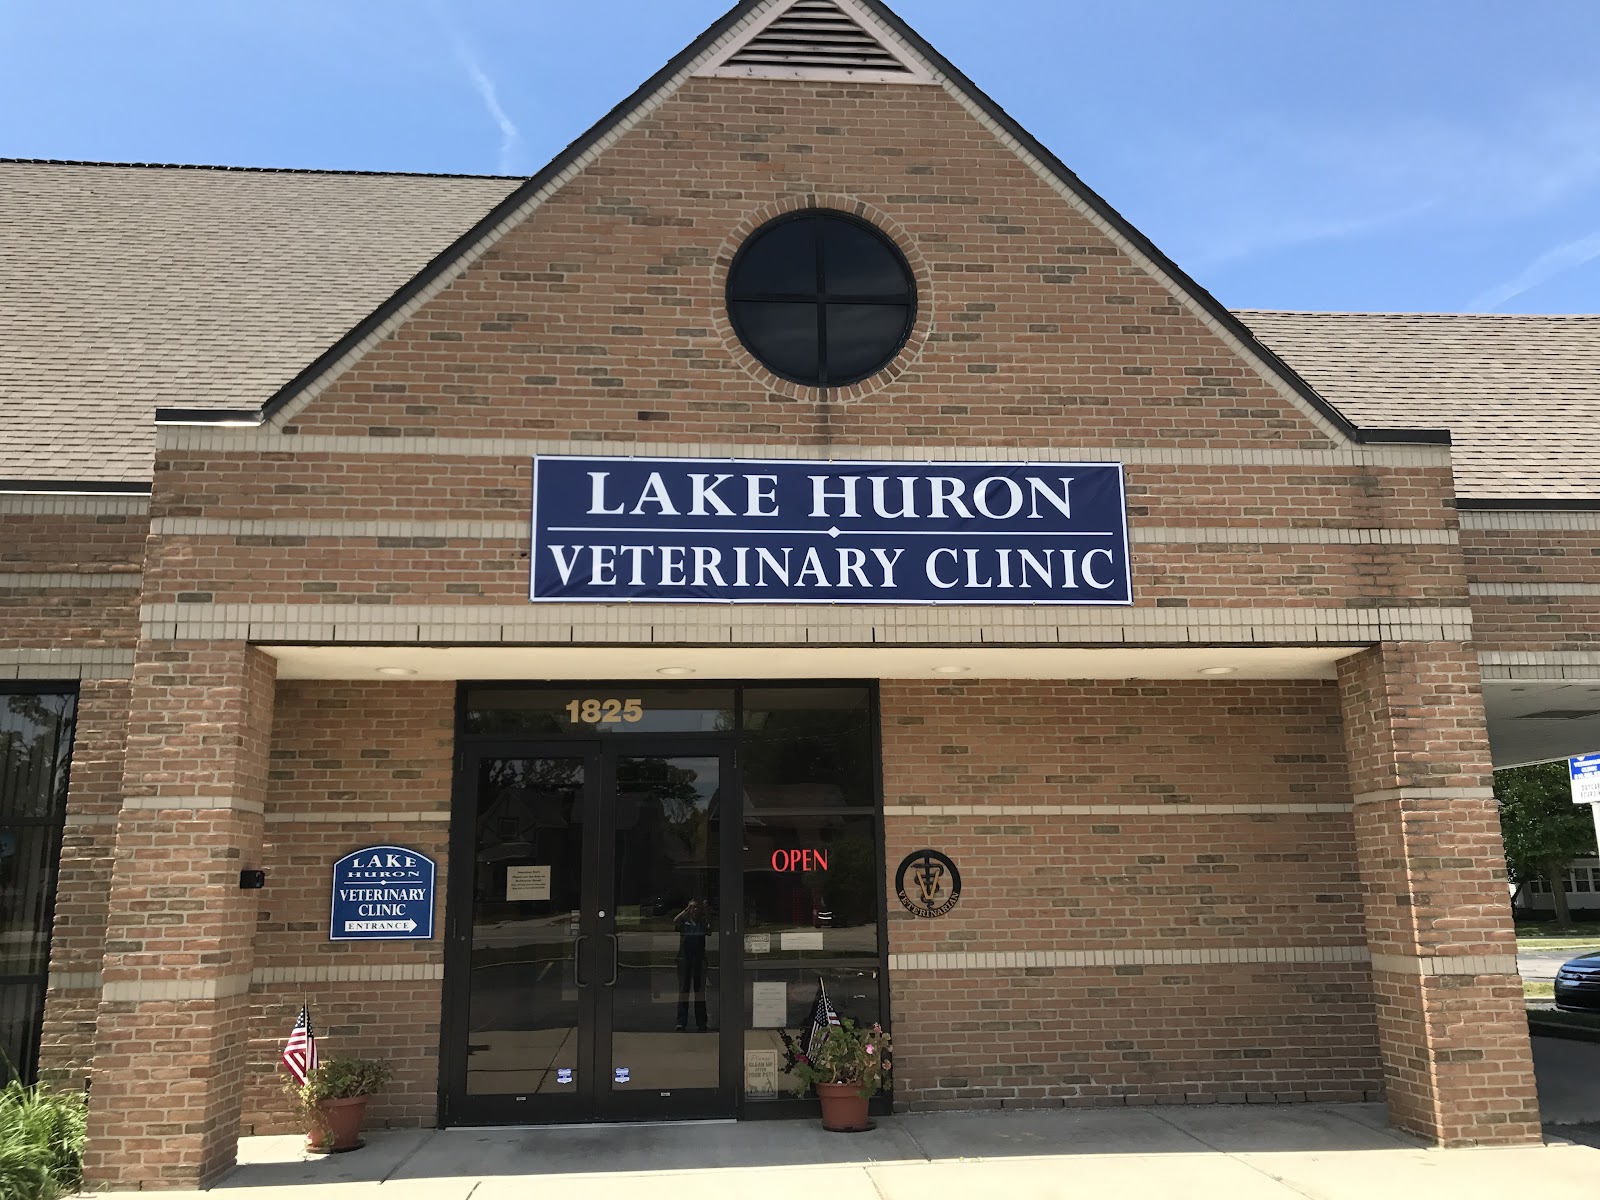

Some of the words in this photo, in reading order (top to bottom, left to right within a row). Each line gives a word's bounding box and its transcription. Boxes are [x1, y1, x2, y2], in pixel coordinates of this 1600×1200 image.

[586, 471, 780, 518] LAKE
[807, 474, 1075, 521] HURON
[547, 543, 905, 589] VETERINARY
[925, 546, 1115, 592] CLINIC
[566, 698, 644, 723] 1825
[352, 853, 417, 868] LAKE
[771, 848, 828, 873] OPEN
[339, 888, 427, 902] VETERINARY
[897, 889, 960, 918] VETERINARIAN
[358, 903, 407, 917] CLINIC
[348, 922, 410, 931] ENTRANCE
